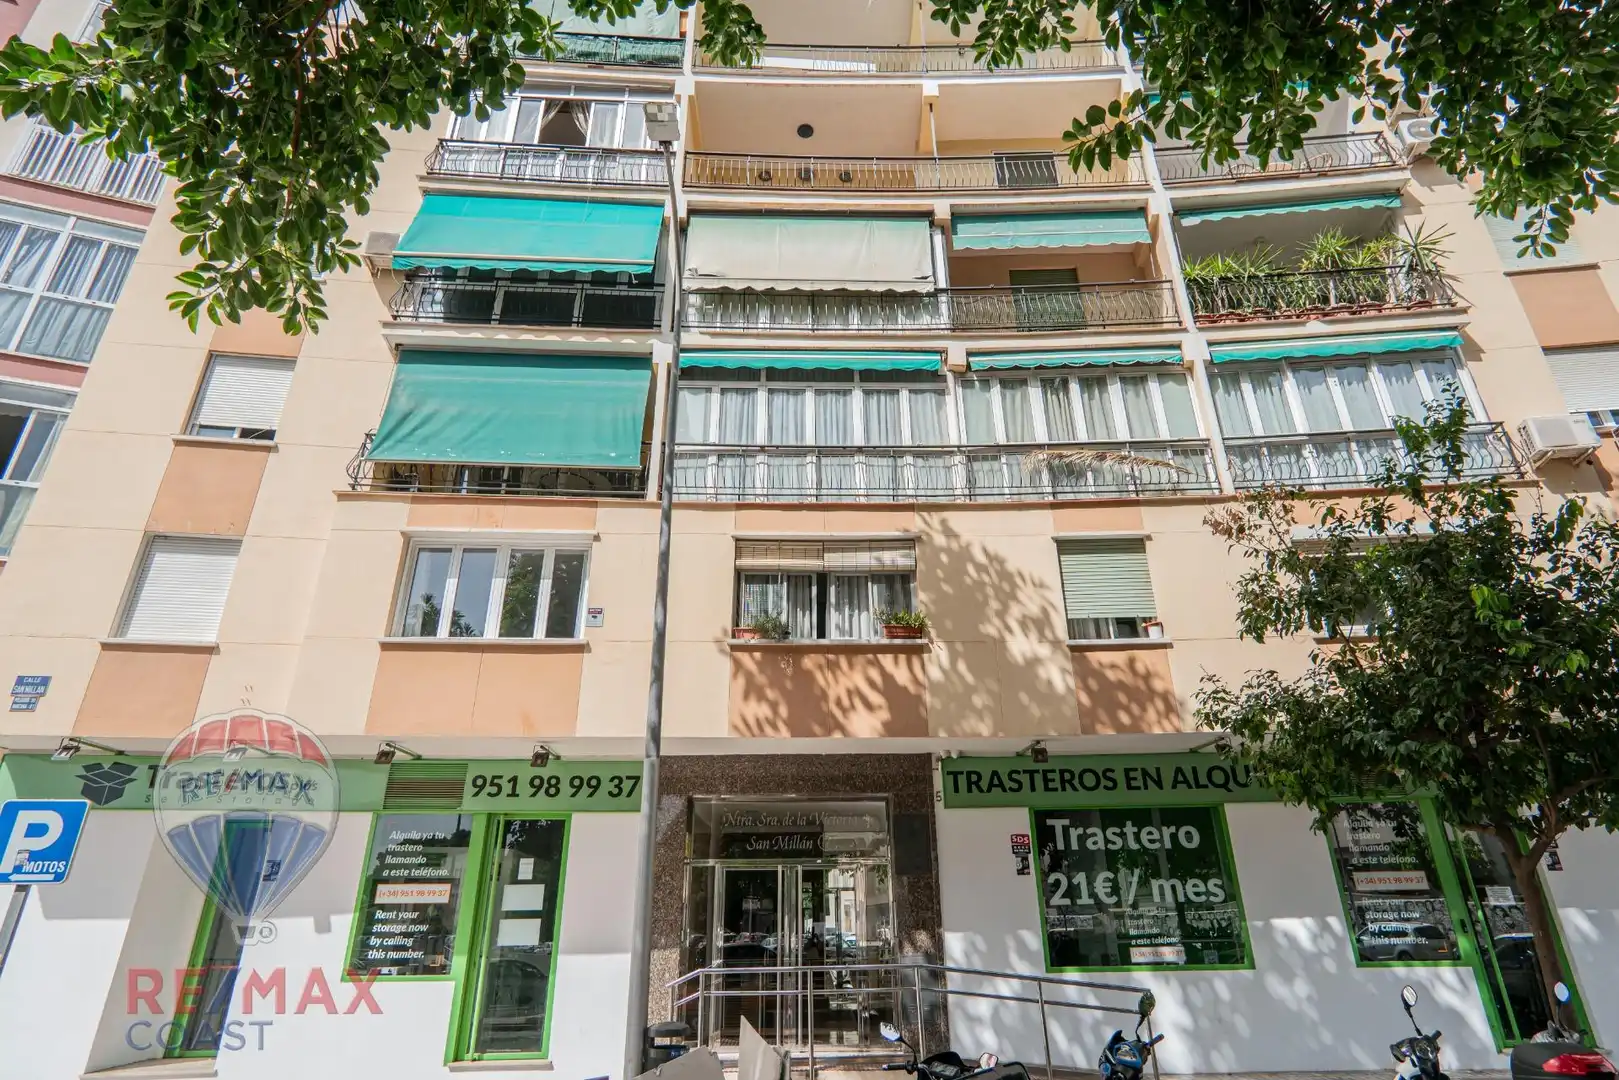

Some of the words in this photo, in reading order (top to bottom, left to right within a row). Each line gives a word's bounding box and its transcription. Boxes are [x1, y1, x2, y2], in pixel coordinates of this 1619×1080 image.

[13, 685, 24, 693] SAN
[946, 768, 1118, 794] TRASTEROS
[1124, 767, 1163, 791] EN
[1171, 765, 1253, 792] ALQU
[471, 774, 520, 798] 951
[528, 774, 561, 798] 98
[568, 774, 602, 798] 99
[607, 775, 641, 798] 37
[723, 810, 755, 827] Ntra.
[757, 811, 780, 827] Sra.
[782, 811, 794, 826] de
[796, 811, 807, 826] la
[388, 830, 422, 842] Alquila
[422, 832, 434, 842] ya
[435, 830, 445, 840] tu
[1011, 835, 1029, 844] SDS
[1046, 818, 1200, 850] Trastero
[0, 810, 64, 873] P
[746, 835, 770, 850] San
[772, 834, 813, 850] Millán
[387, 843, 423, 852] trastero
[384, 855, 427, 864] llamando
[1359, 856, 1378, 864] este
[22, 861, 66, 873] MOTOS
[382, 869, 390, 877] a
[390, 869, 409, 877] este
[411, 866, 450, 877] teléfono.
[438, 889, 448, 897] 37
[1150, 877, 1226, 903] mes
[374, 909, 397, 919] Rent
[398, 911, 419, 921] your
[1365, 910, 1399, 919] storage
[371, 923, 407, 934] storage
[408, 924, 429, 932] now
[1368, 922, 1380, 933] by
[369, 936, 382, 947] by
[383, 936, 414, 947] calling
[1372, 935, 1390, 945] this
[367, 949, 386, 959] this
[387, 949, 425, 959] number.
